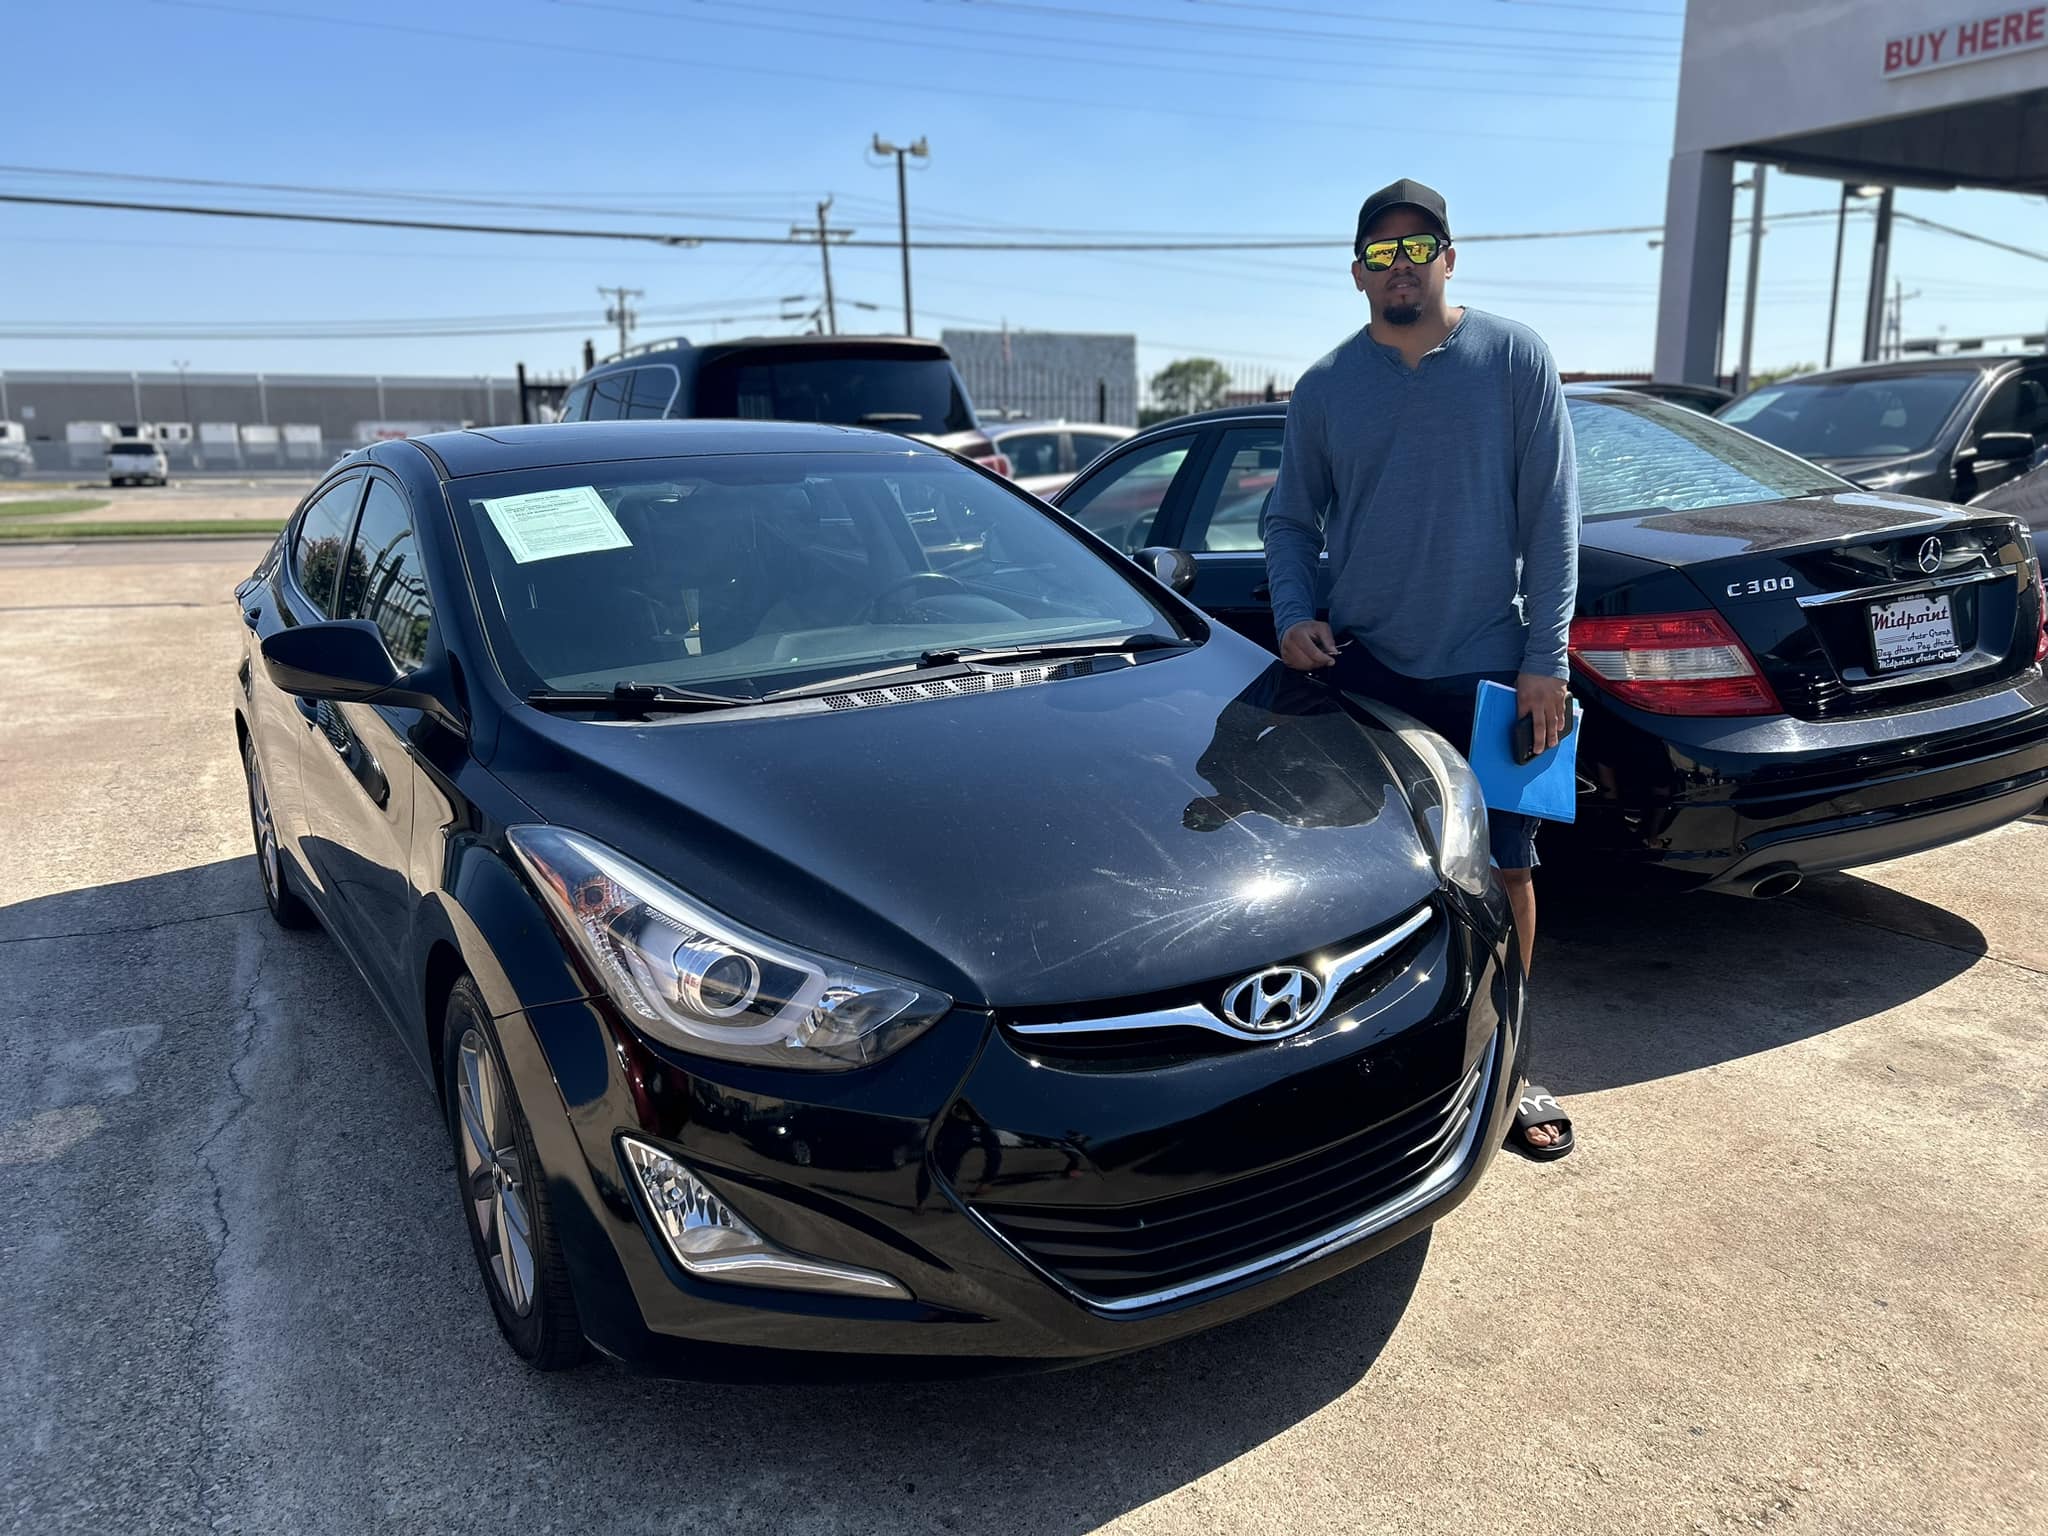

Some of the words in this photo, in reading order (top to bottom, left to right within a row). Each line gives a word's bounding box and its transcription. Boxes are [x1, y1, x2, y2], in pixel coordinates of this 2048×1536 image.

[1884, 29, 1947, 72] BUY
[1957, 7, 2046, 56] HERE
[1727, 583, 1742, 597] C
[1746, 576, 1794, 594] 300
[1871, 606, 1949, 630] Midpoint
[1907, 632, 1928, 641] Auto
[1929, 629, 1951, 638] Group
[1878, 657, 1914, 668] Midpoint
